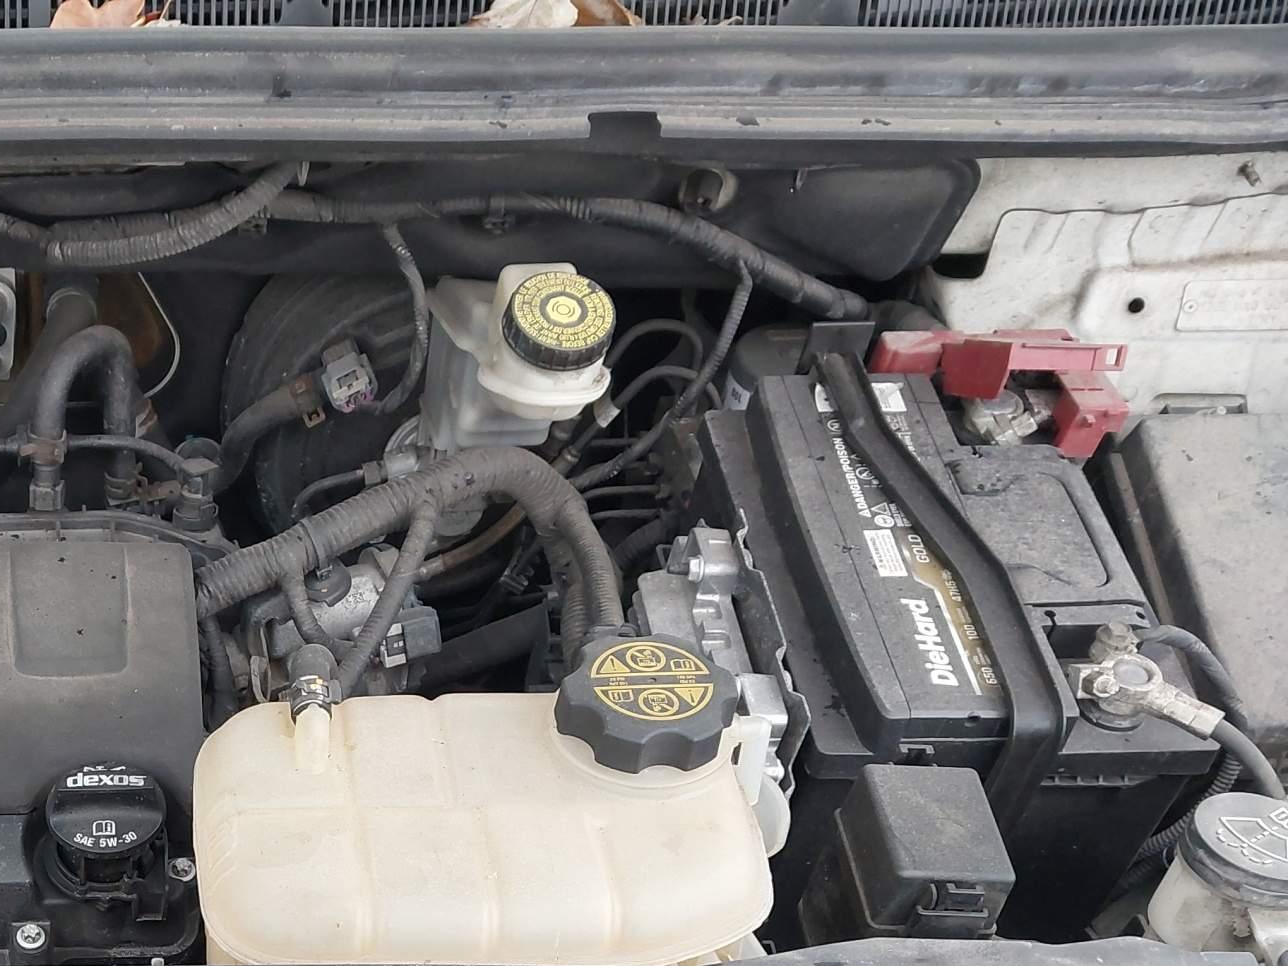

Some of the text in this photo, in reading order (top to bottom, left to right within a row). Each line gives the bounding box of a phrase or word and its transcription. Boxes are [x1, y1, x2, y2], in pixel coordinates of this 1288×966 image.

[832, 437, 869, 511] DANGER/POISON
[907, 534, 930, 563] GOLD
[964, 624, 979, 640] 100
[900, 598, 960, 686] DieHard
[981, 666, 998, 685] 650
[66, 772, 147, 788] dexos
[73, 831, 138, 848] SAE 5W-30
